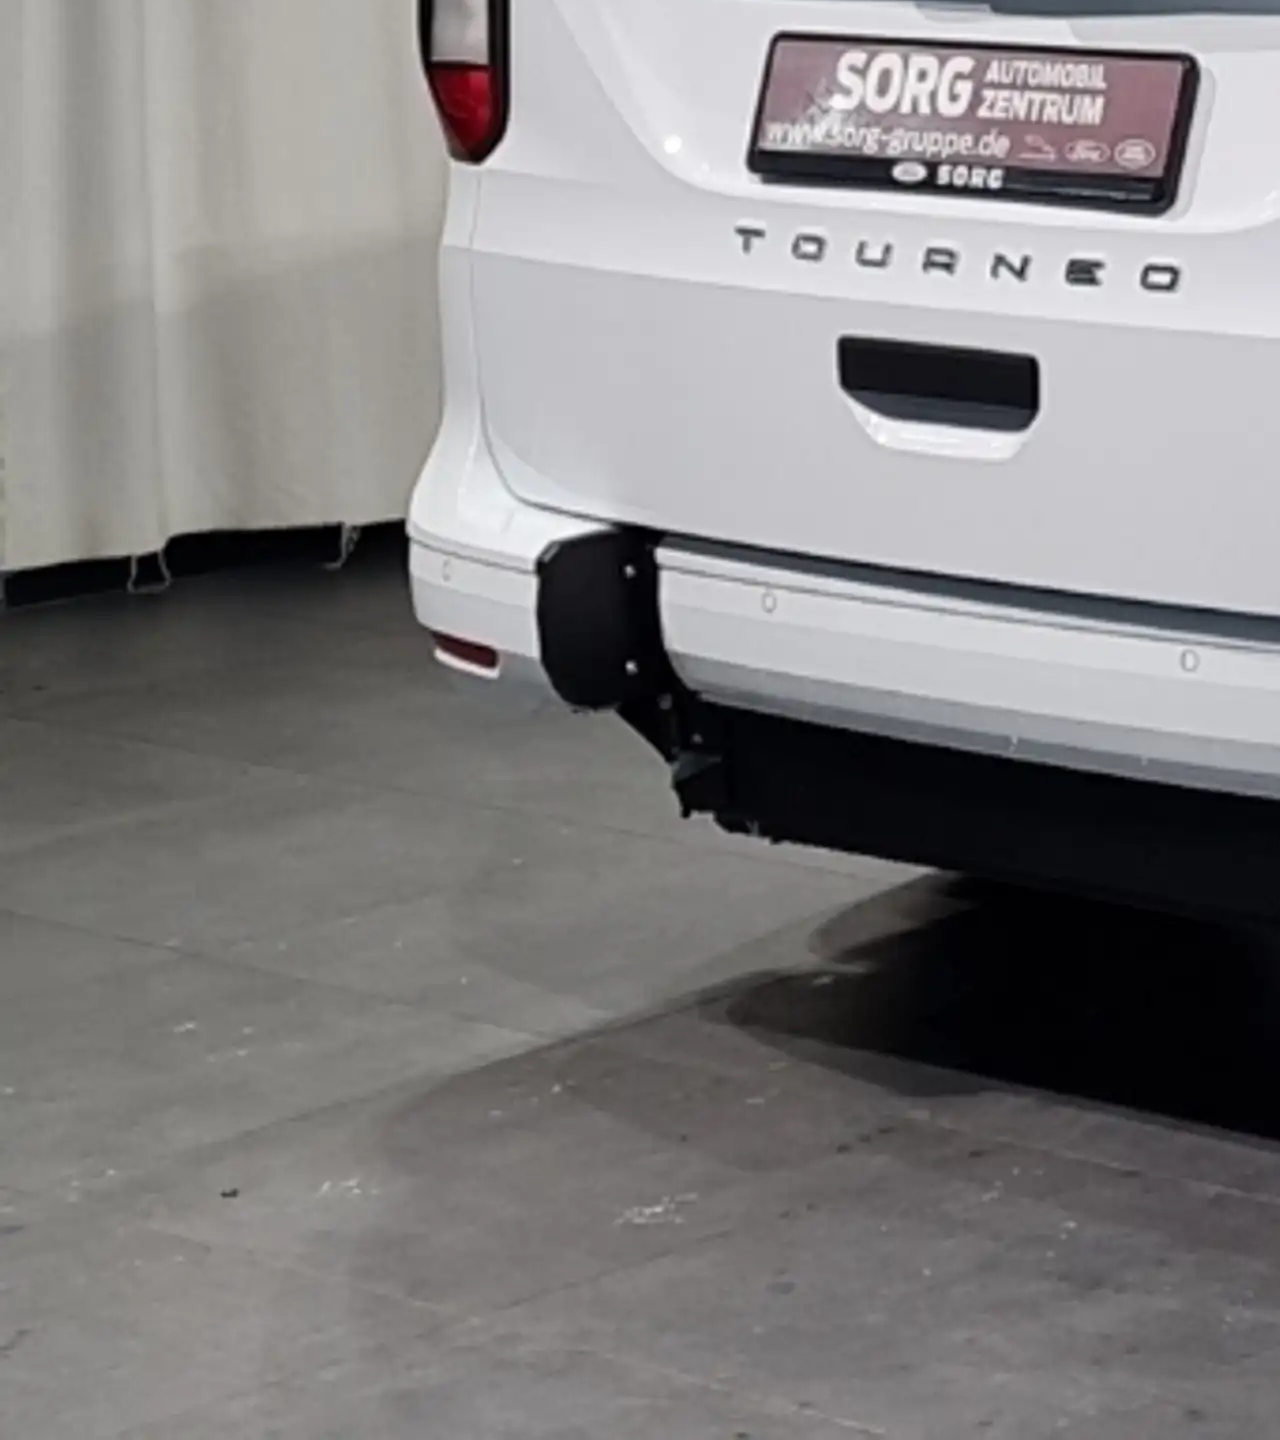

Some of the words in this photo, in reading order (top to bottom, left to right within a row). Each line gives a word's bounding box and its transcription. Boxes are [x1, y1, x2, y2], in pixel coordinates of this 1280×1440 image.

[828, 51, 976, 118] SORG
[982, 59, 1107, 90] AUTOMOBIL
[975, 88, 1106, 126] ZENTRUM
[936, 163, 1004, 191] SORG
[734, 225, 1182, 293] TOURNEO
